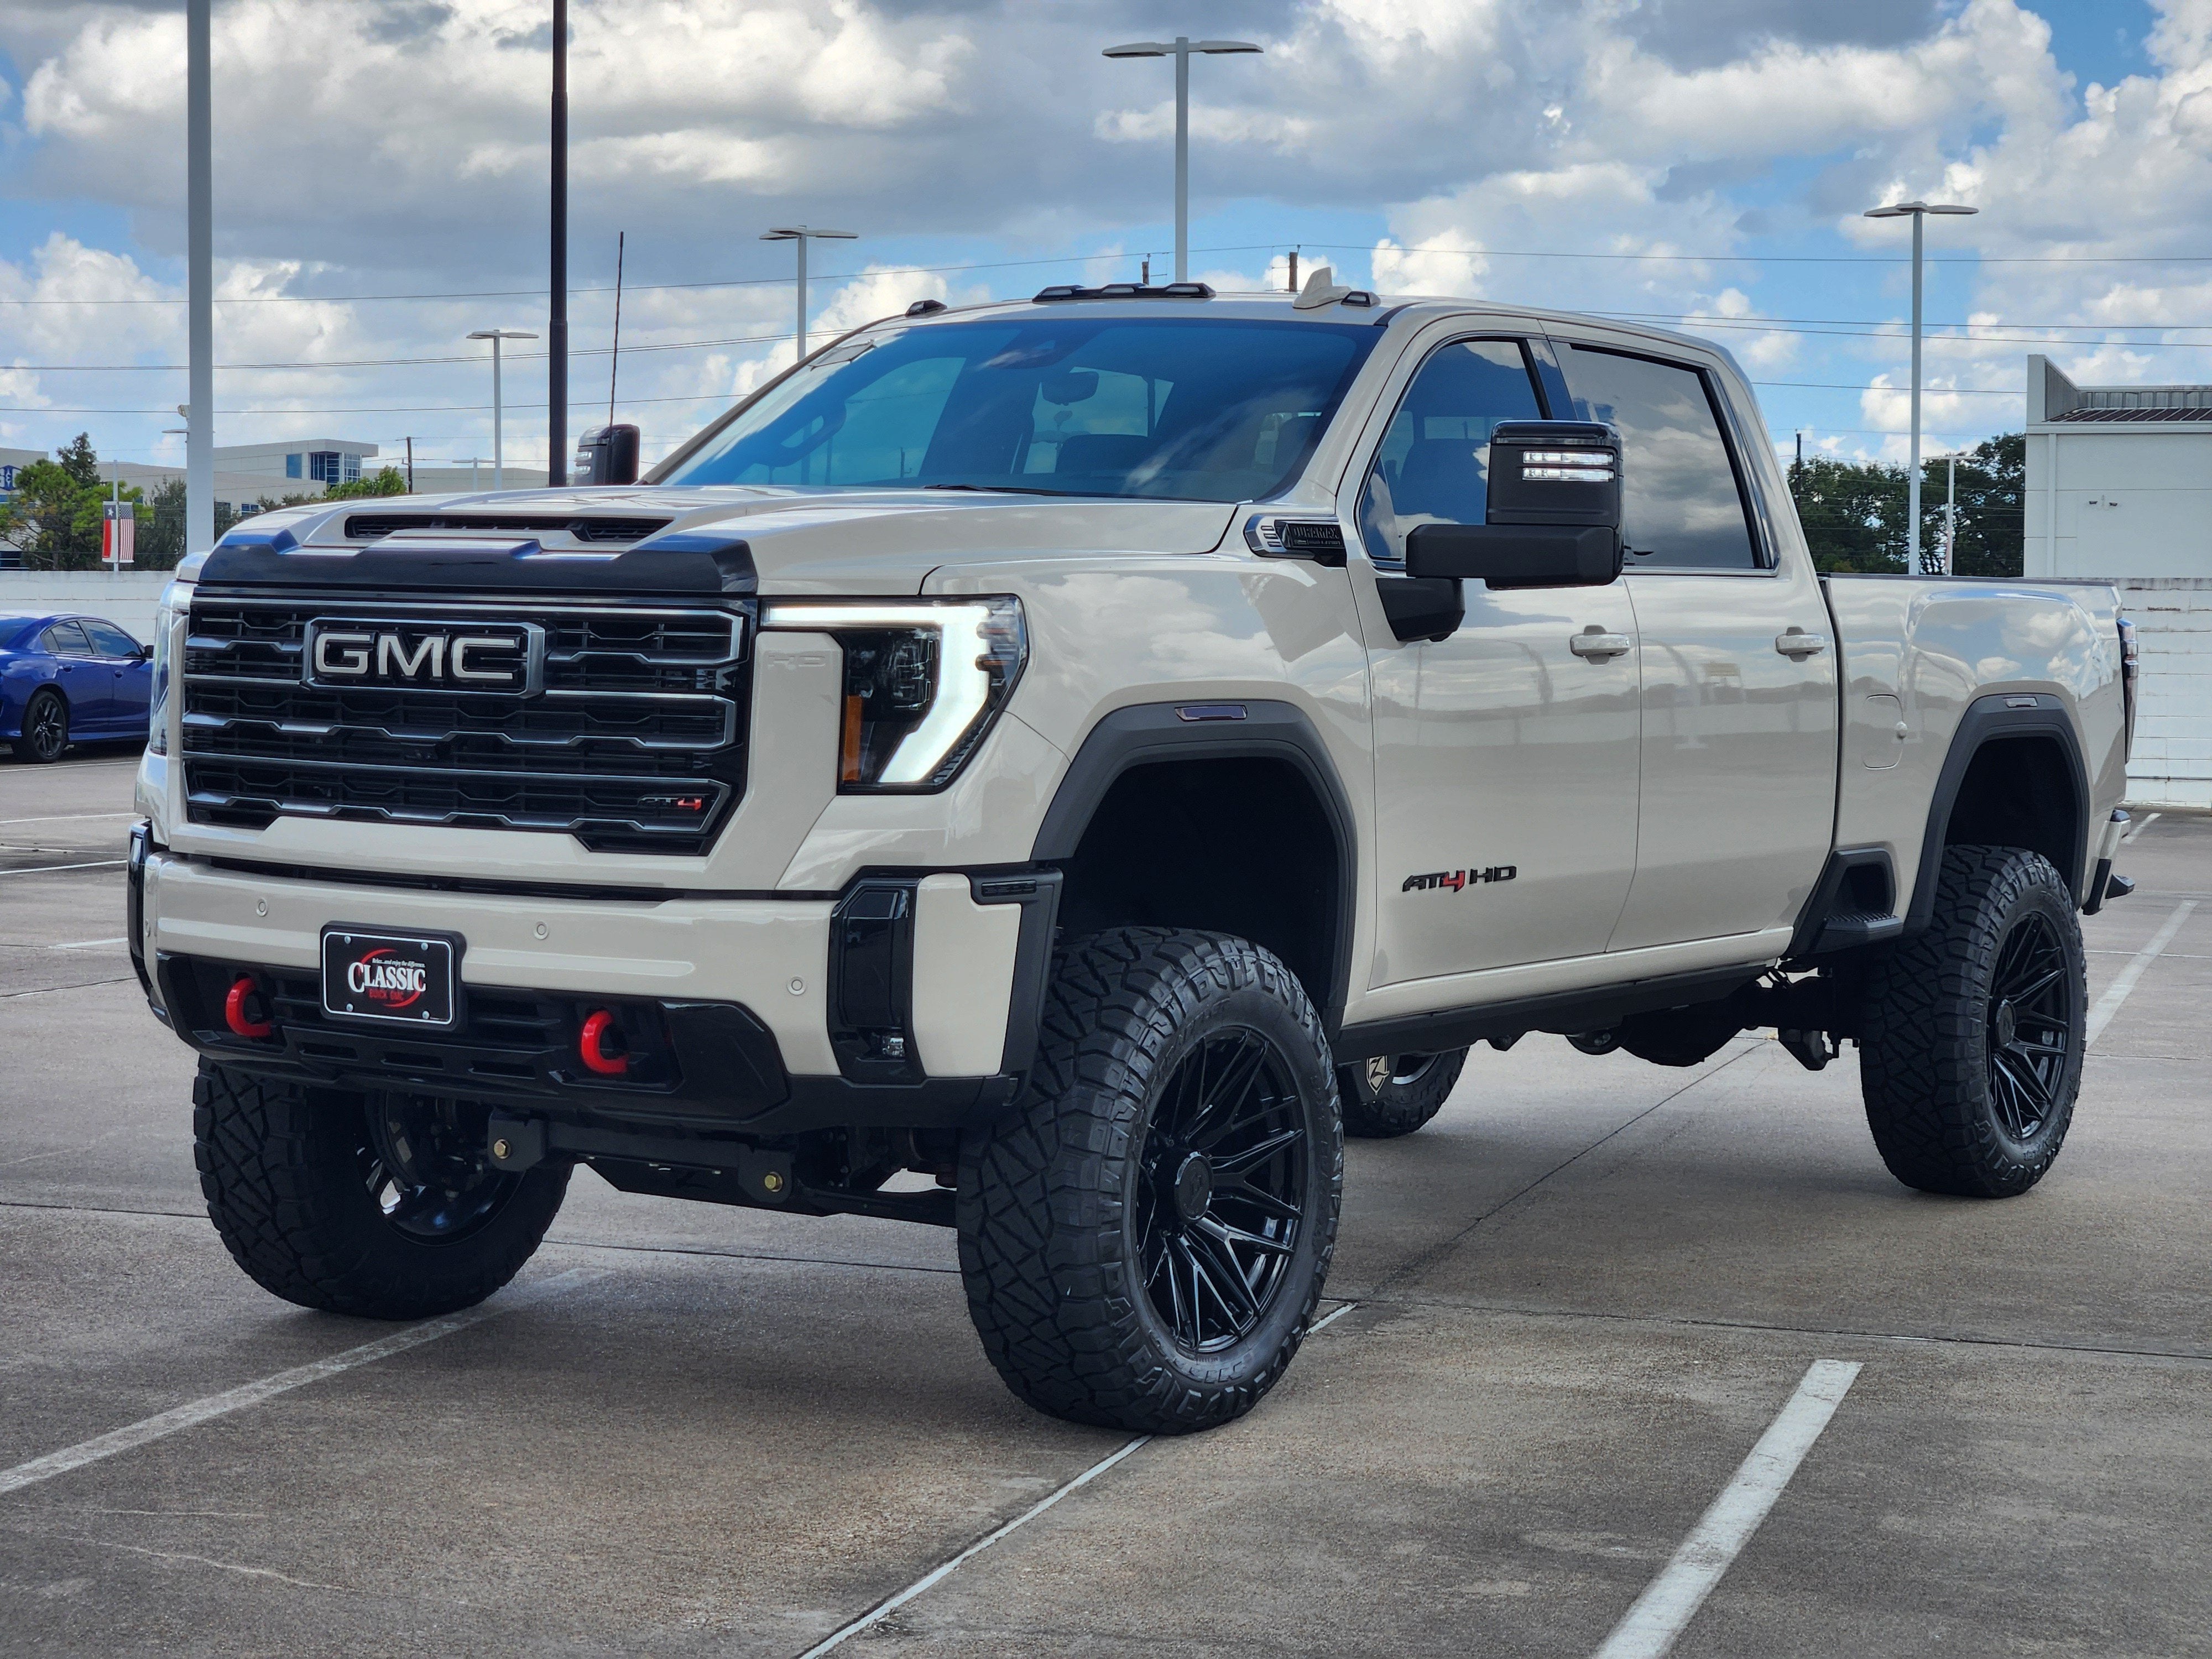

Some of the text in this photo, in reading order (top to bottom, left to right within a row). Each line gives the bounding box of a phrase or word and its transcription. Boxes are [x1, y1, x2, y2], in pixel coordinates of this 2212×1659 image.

[1293, 526, 1340, 539] DURAMAX
[315, 633, 516, 680] GMC
[1402, 864, 1517, 893] AT4 HD
[348, 962, 426, 993] CLASSIC
